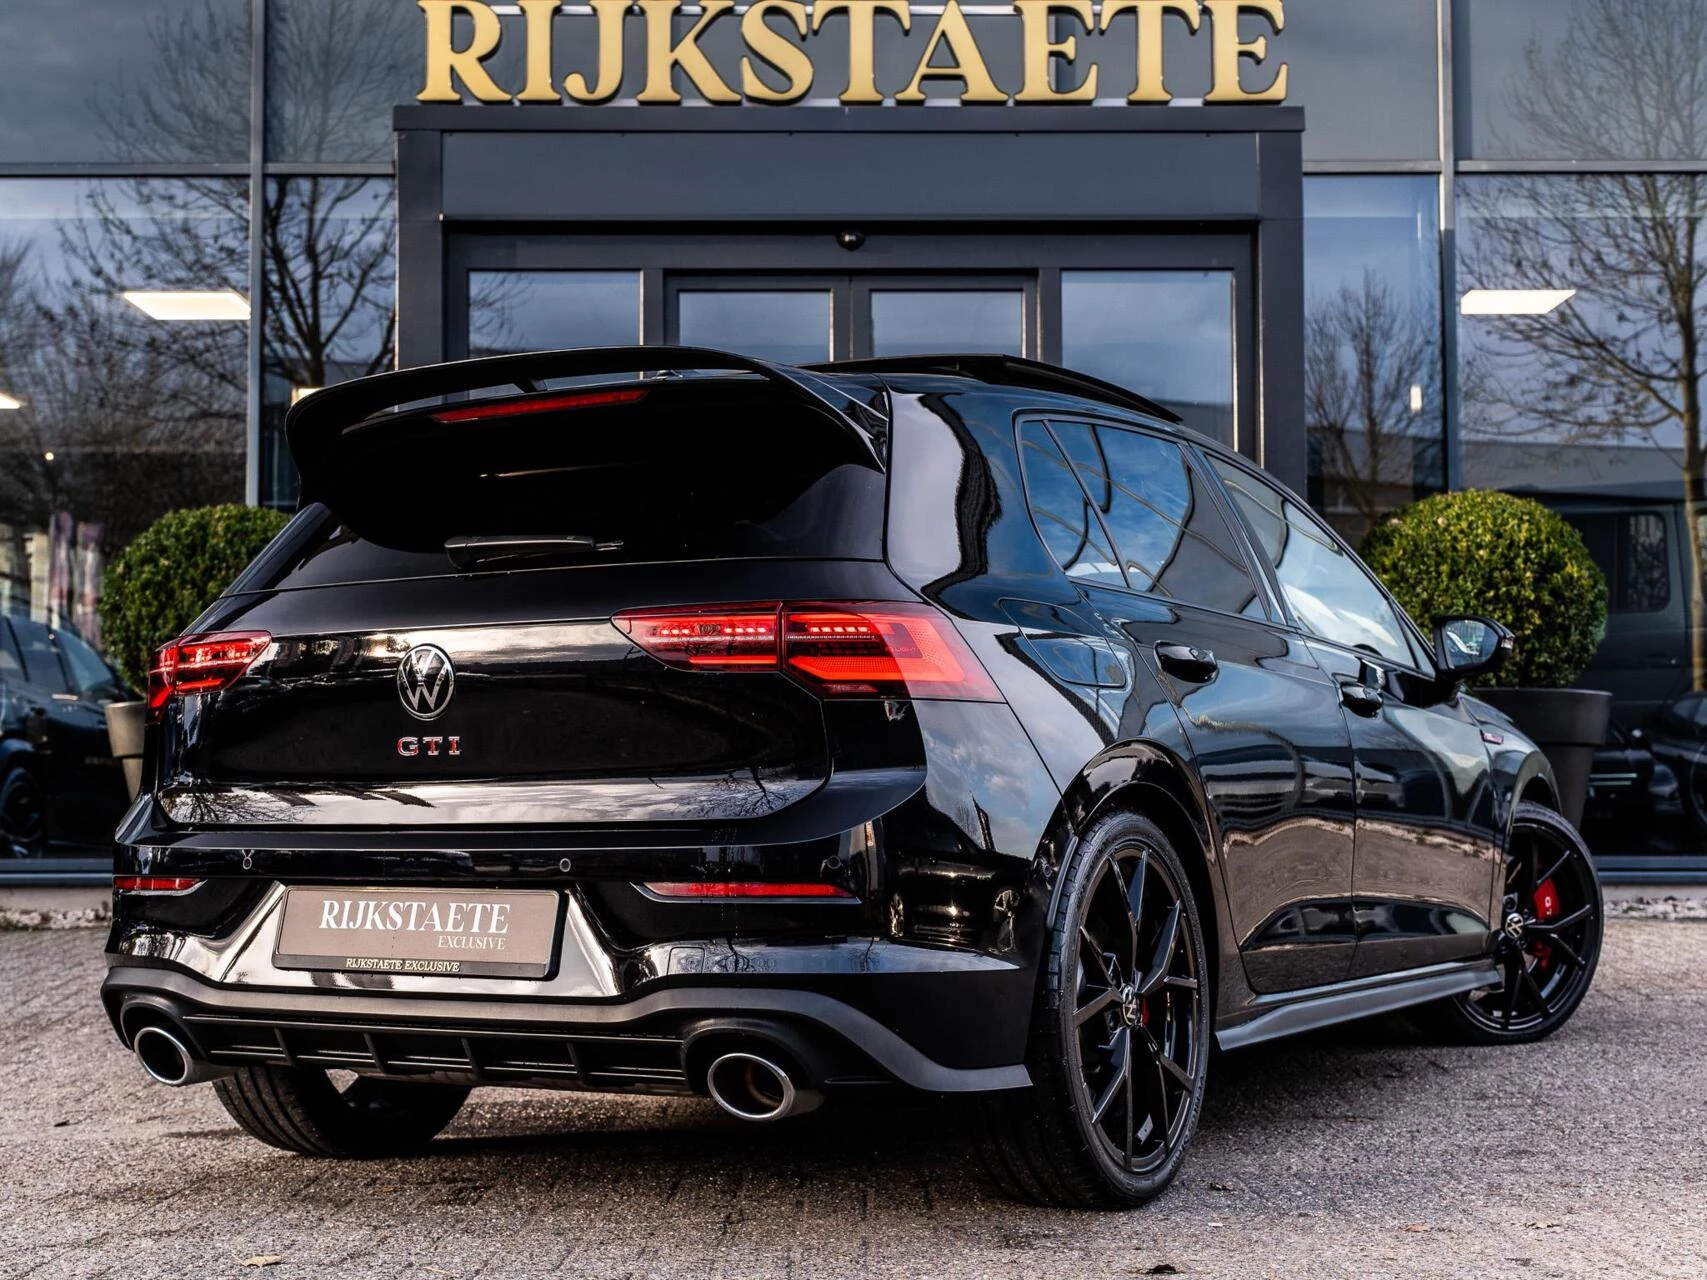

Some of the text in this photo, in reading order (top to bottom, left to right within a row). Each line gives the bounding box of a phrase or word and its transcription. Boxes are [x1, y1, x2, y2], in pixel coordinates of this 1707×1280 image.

[416, 0, 1289, 104] RIJKSTAETE
[397, 736, 461, 756] GTI
[319, 899, 511, 934] RIJKSTAETE
[438, 935, 506, 950] EXCLUSIVE
[345, 958, 460, 973] RIJKSTAETE EXCLUSIVE
